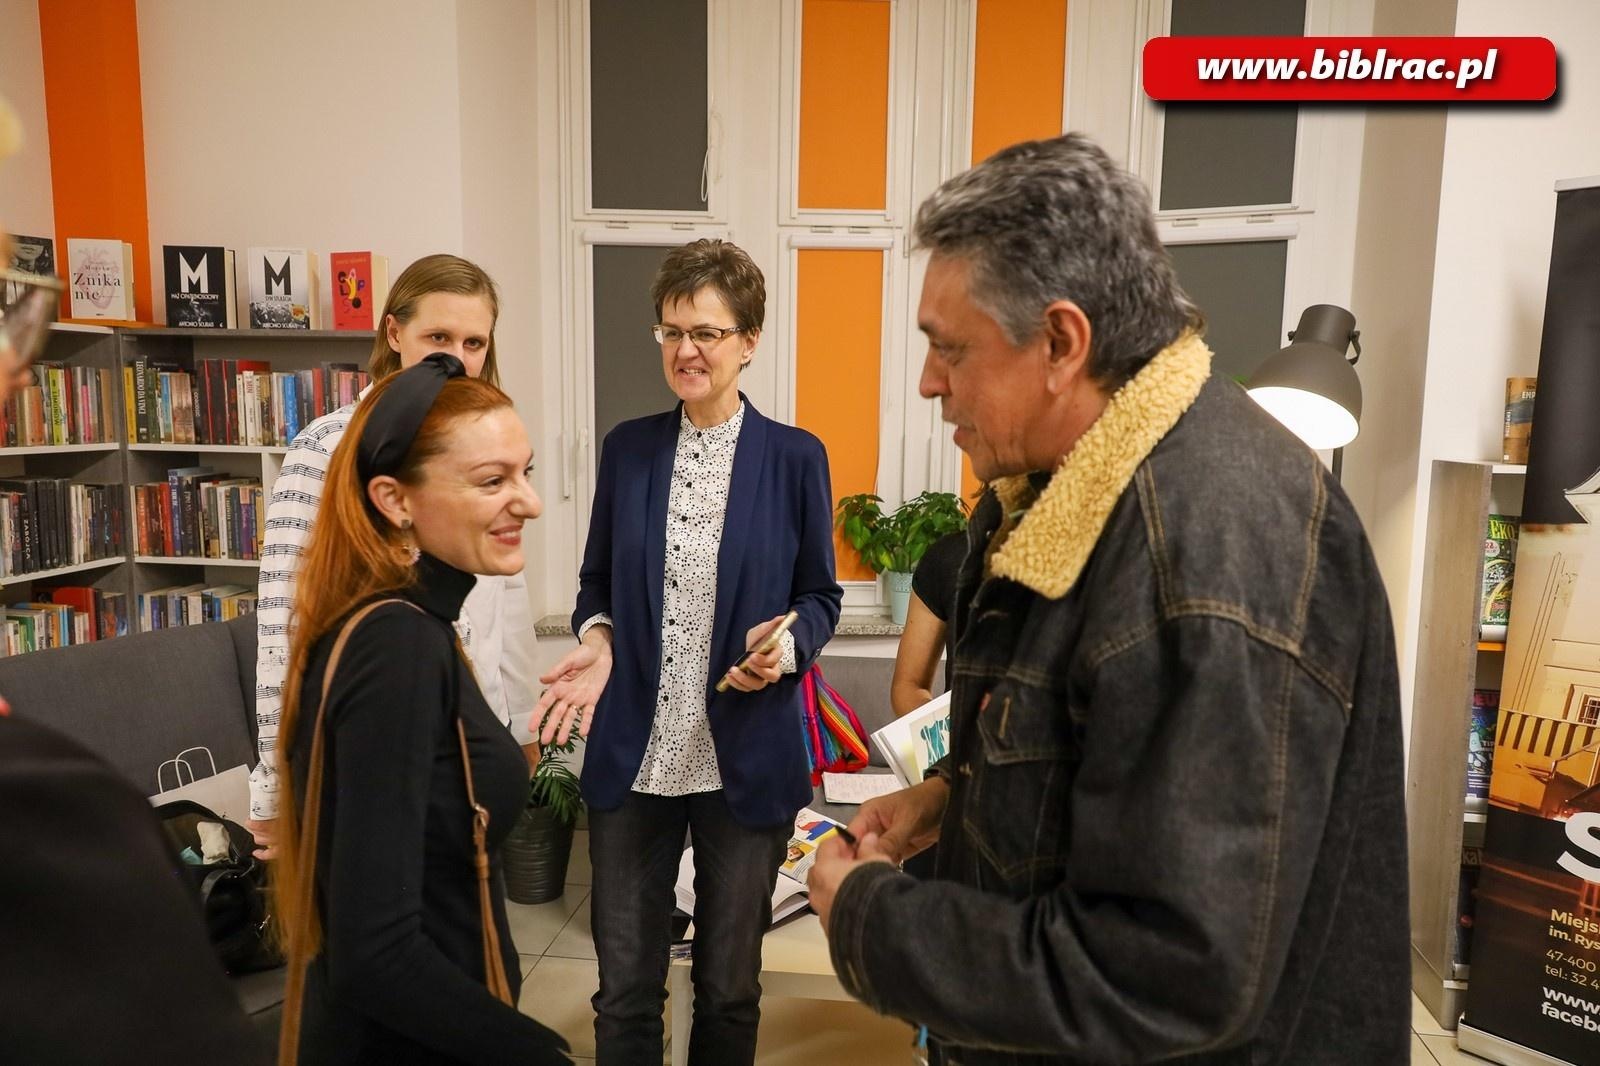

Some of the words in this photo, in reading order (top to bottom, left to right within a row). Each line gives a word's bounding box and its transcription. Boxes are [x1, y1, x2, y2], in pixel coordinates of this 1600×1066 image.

[73, 272, 121, 287] Znika
[179, 252, 209, 293] M
[263, 255, 292, 295] M
[75, 287, 100, 300] nie
[135, 361, 145, 391] LEONARDO
[138, 399, 146, 415] VINCI
[23, 519, 31, 560] ZABÓJCA
[1551, 909, 1600, 935] Miejs
[1549, 925, 1571, 942] im.
[1574, 934, 1600, 950] Rys
[1546, 949, 1596, 973] 47-400
[1545, 964, 1568, 980] tel.:
[1570, 971, 1588, 987] 32
[1541, 1001, 1600, 1033] faceb
